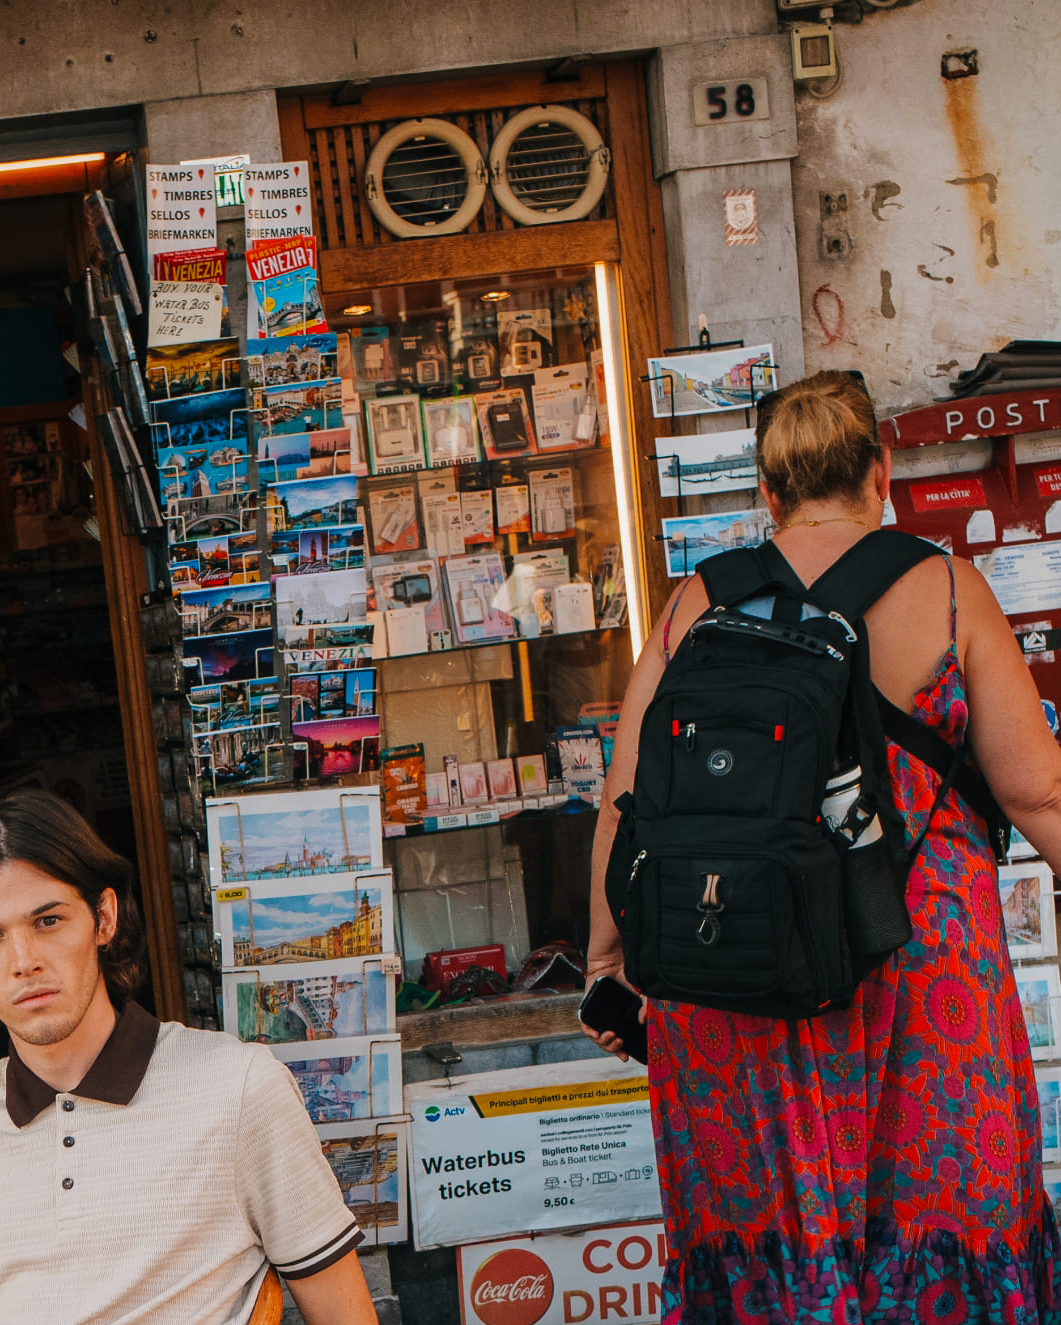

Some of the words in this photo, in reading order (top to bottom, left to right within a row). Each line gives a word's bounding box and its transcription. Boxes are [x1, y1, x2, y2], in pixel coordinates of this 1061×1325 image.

[707, 84, 756, 120] 58
[149, 172, 193, 182] STAMPS
[245, 170, 289, 181] STAMPS
[163, 190, 213, 201] TIMBRES
[260, 188, 308, 199] TIMBRES
[150, 210, 191, 221] SELLOS
[248, 208, 288, 219] SELLOS
[148, 229, 215, 240] BRIEFMARKEN
[246, 227, 311, 238] BRIEFMARKEN
[172, 259, 223, 282] VENEZIA
[251, 247, 308, 279] VENEZIA
[946, 399, 1050, 434] POST
[926, 493, 939, 502] PER
[940, 492, 949, 500] LA
[289, 646, 366, 662] VENEZIA
[444, 1106, 465, 1117] Actv
[489, 1096, 528, 1109] Principali
[529, 1093, 561, 1104] biglietti
[569, 1091, 594, 1101] prezzi
[610, 1085, 650, 1096] trasporto
[539, 1116, 568, 1126] Biglietto
[569, 1113, 600, 1122] ordinario
[605, 1109, 636, 1119] Standard
[541, 1145, 578, 1157] Biglietto
[580, 1143, 599, 1152] Rete
[601, 1140, 627, 1150] Unica
[422, 1149, 526, 1175] Waterbus
[542, 1159, 558, 1168] Bus
[560, 1157, 566, 1165] &
[567, 1155, 587, 1165] Boat
[589, 1152, 612, 1162] ticket
[439, 1177, 512, 1200] tickets
[543, 1196, 568, 1208] 9,50
